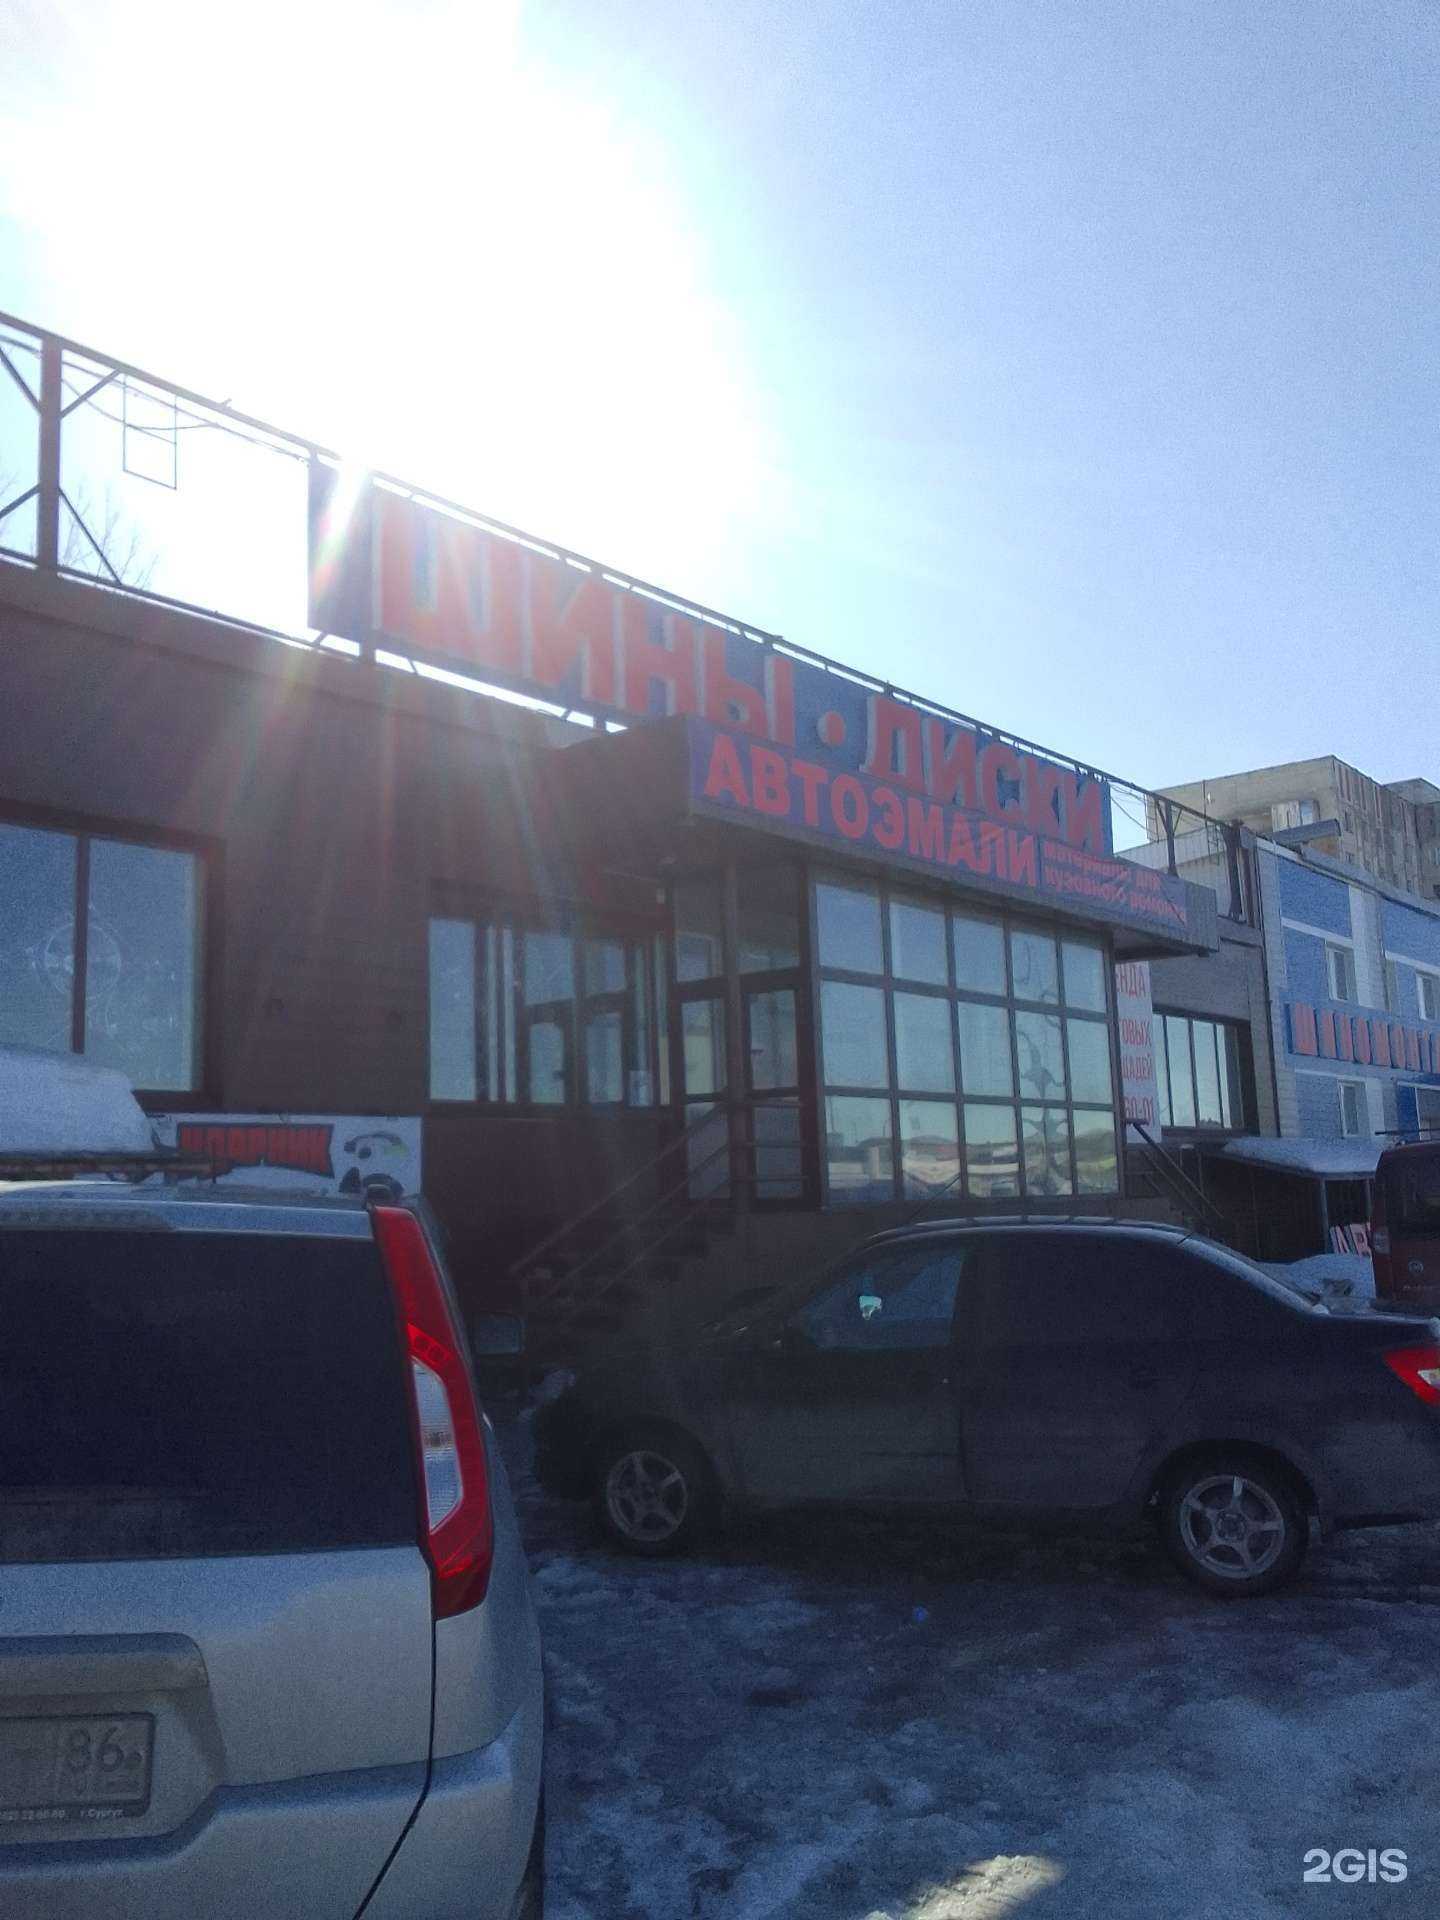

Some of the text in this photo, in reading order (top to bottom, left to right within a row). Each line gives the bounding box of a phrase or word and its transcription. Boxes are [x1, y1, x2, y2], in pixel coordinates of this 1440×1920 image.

[373, 492, 1106, 856] ШИНЫ ДИСКИ
[703, 732, 1039, 888] АВТОЭМАЛИ
[1119, 1018, 1153, 1049] ОВЫХ
